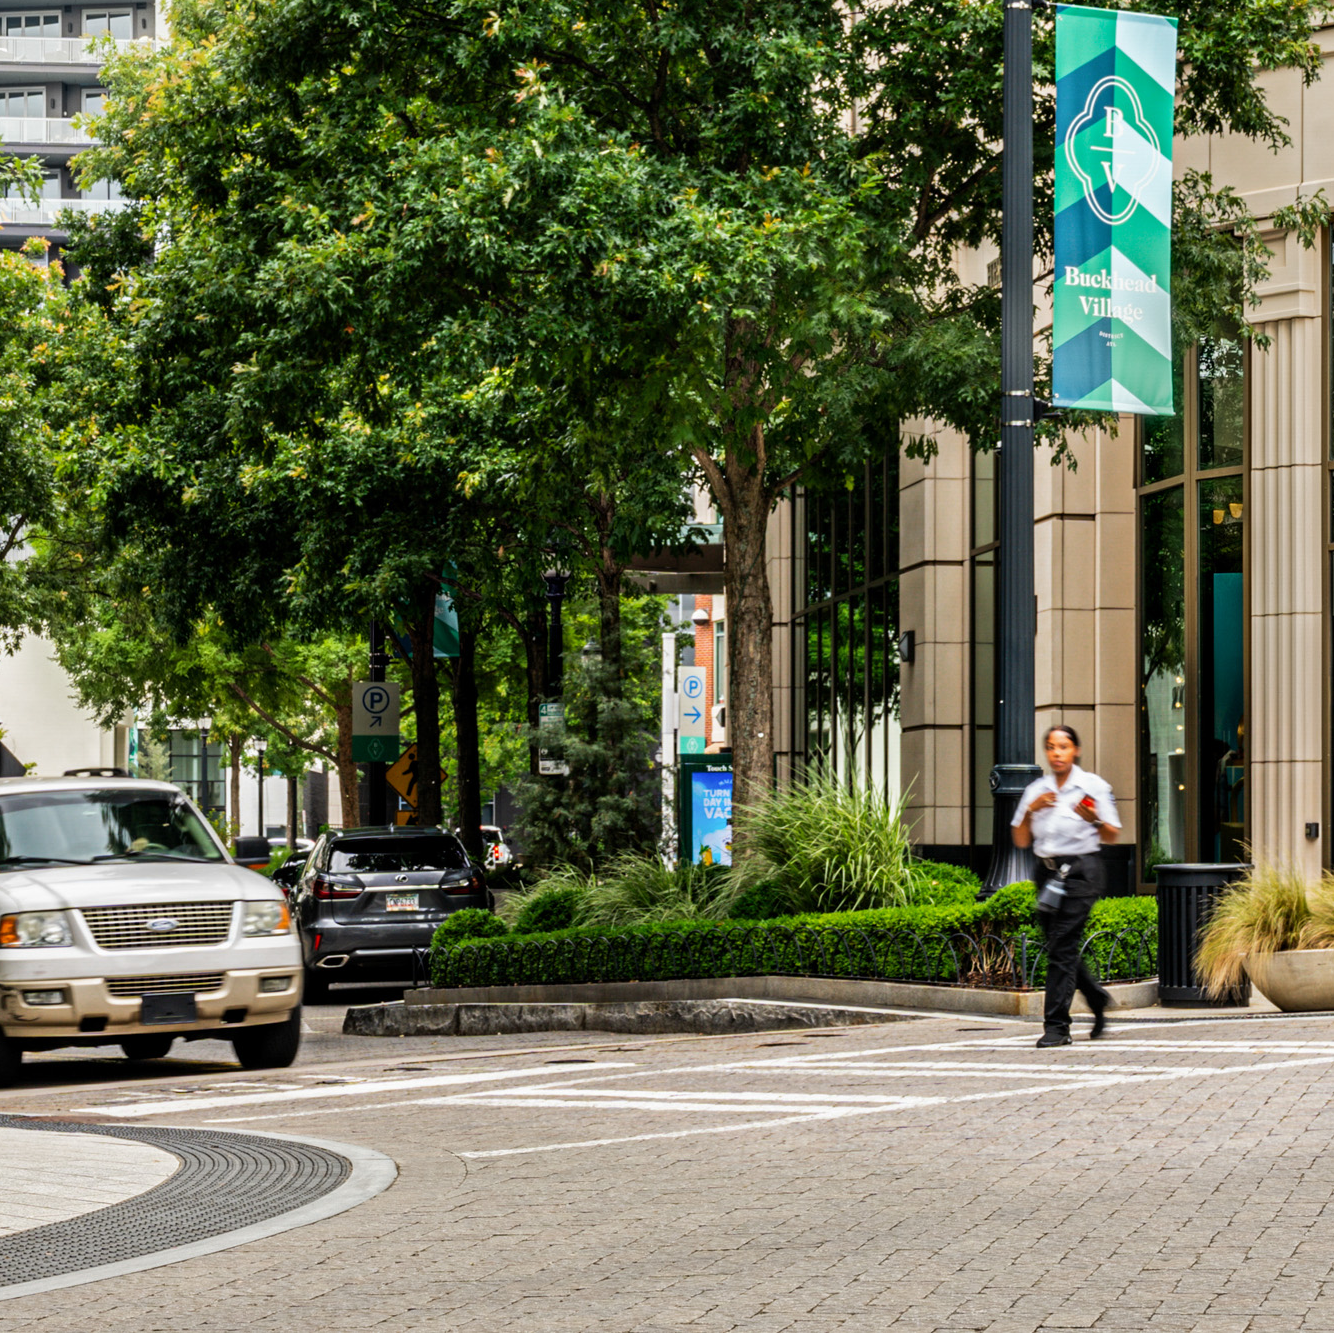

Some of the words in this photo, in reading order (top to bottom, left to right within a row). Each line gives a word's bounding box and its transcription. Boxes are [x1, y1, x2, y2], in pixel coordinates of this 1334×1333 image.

[1103, 106, 1124, 138] B
[1100, 160, 1124, 194] V
[1064, 265, 1157, 294] Buckhead
[1078, 295, 1144, 324] Village
[689, 680, 698, 694] P
[370, 692, 383, 709] P
[703, 789, 731, 797] TURN
[703, 798, 722, 806] DAY
[704, 807, 732, 819] VAC
